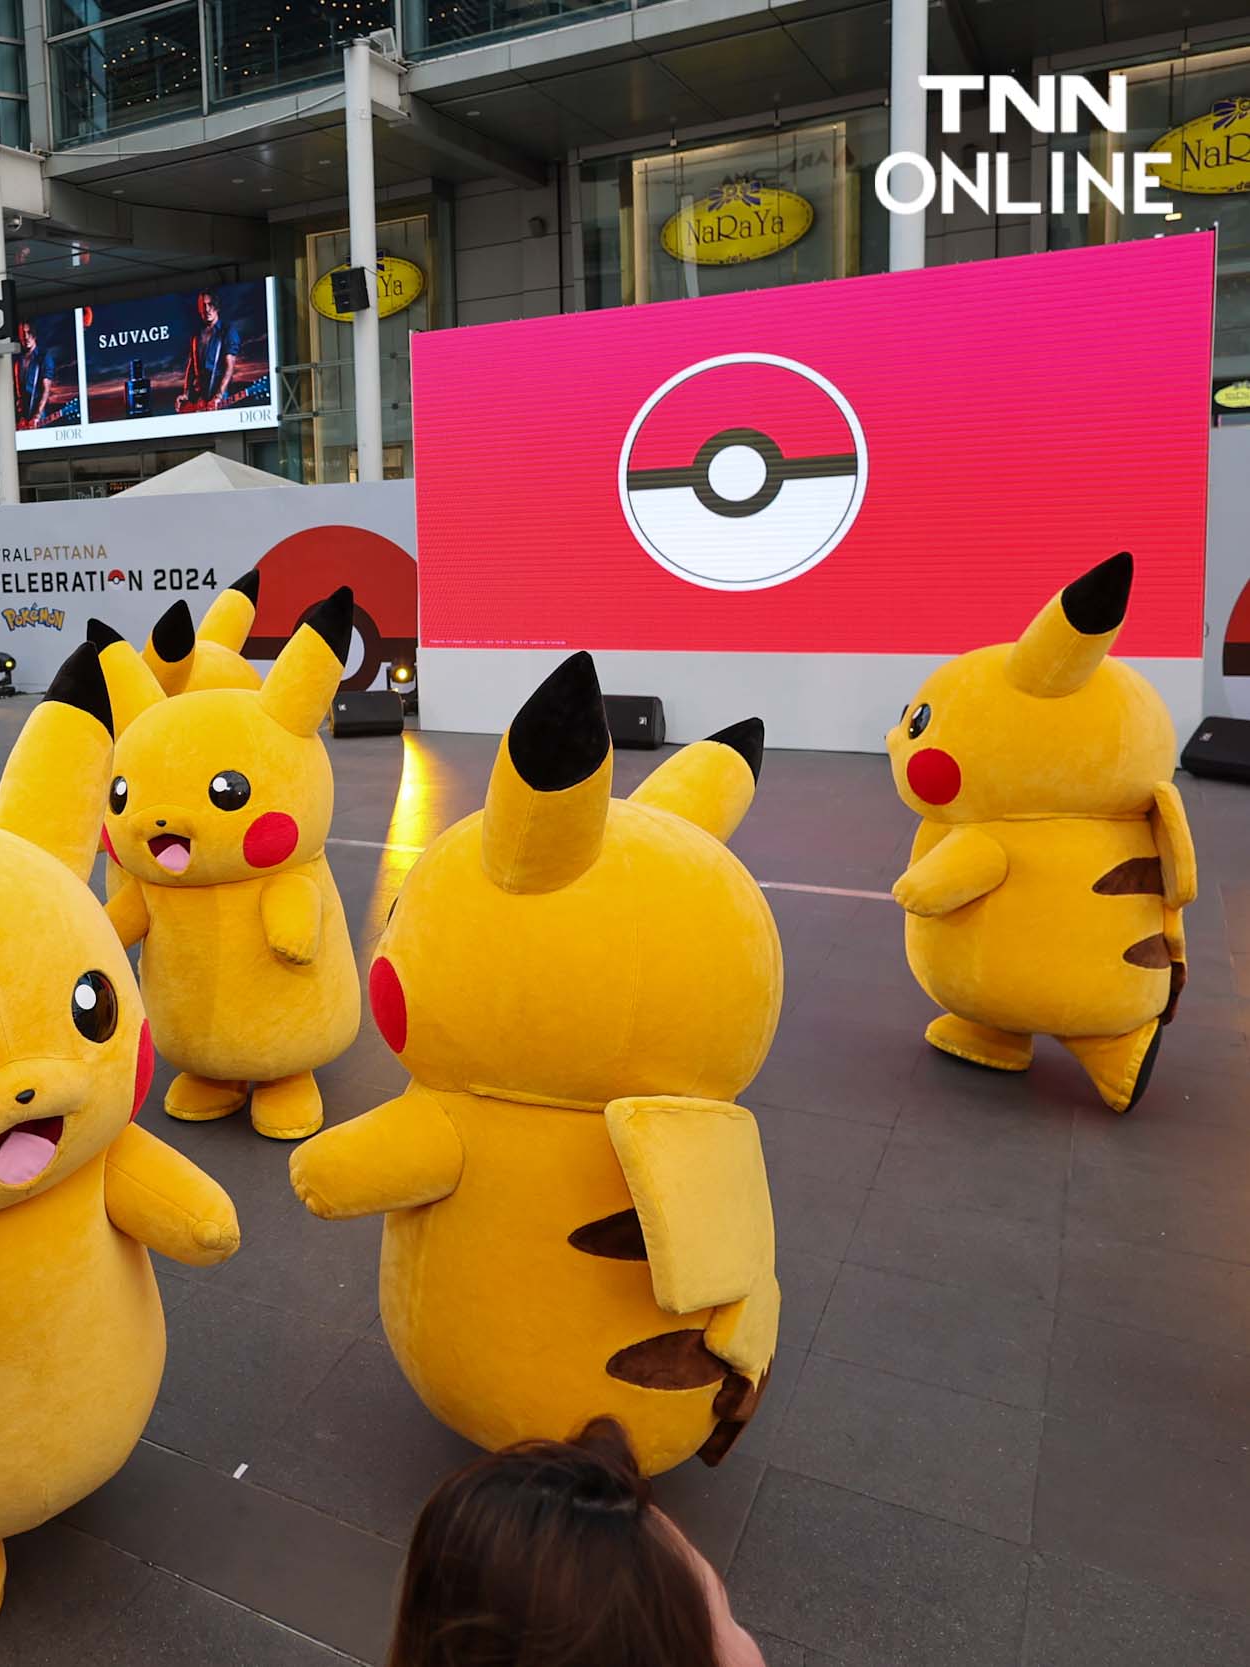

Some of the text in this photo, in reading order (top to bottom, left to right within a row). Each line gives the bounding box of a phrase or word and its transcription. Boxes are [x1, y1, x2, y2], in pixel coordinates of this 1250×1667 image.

[686, 208, 784, 246] NaRaYa
[99, 325, 170, 349] SAUVAGE
[239, 409, 272, 424] DIOR
[55, 428, 83, 441] DIOR
[153, 567, 217, 591] 2024
